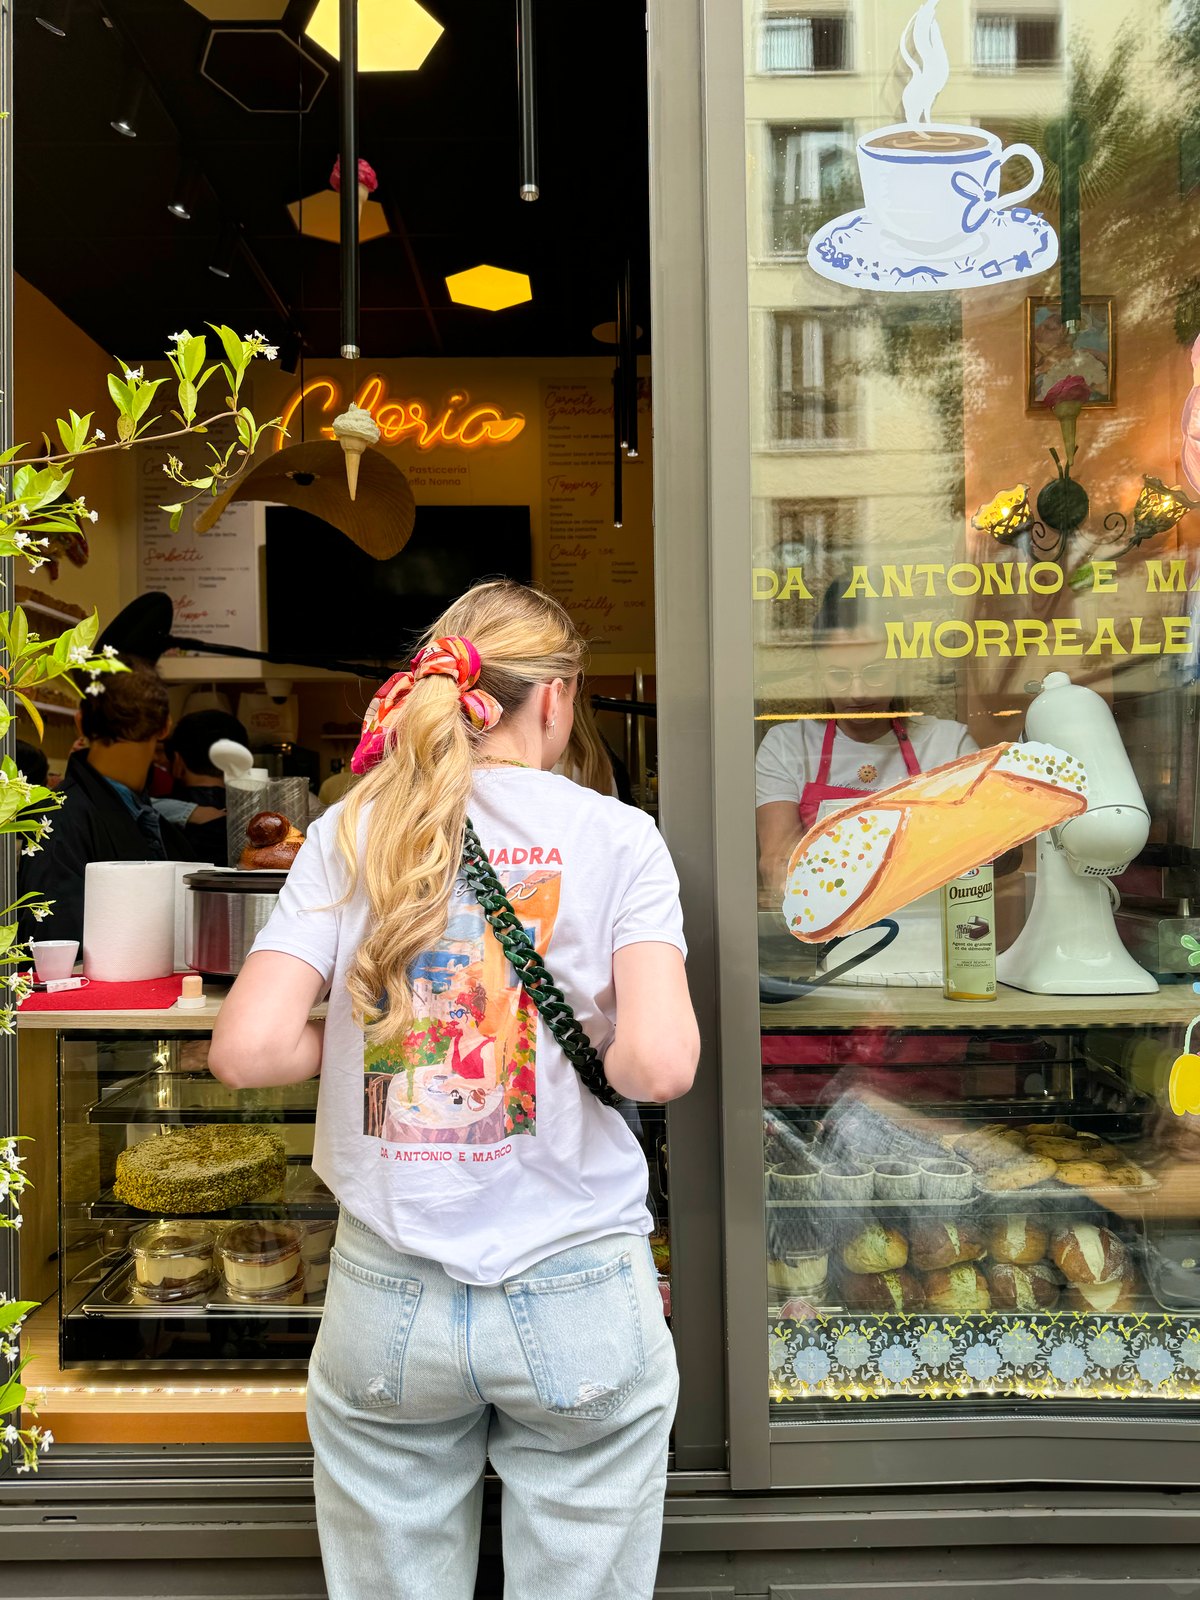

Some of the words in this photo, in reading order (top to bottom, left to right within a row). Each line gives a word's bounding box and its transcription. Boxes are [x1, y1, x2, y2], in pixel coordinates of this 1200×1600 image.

[277, 376, 524, 449] Gloria
[409, 466, 467, 474] Pasticceria
[752, 568, 813, 600] DA
[842, 562, 1064, 598] ANTONIO
[1091, 561, 1119, 593] E
[884, 617, 1194, 659] MORREALE
[949, 881, 993, 900] Ouragan
[394, 1150, 453, 1161] ANTONIO
[458, 1151, 466, 1162] E
[472, 1143, 512, 1162] MARCO
